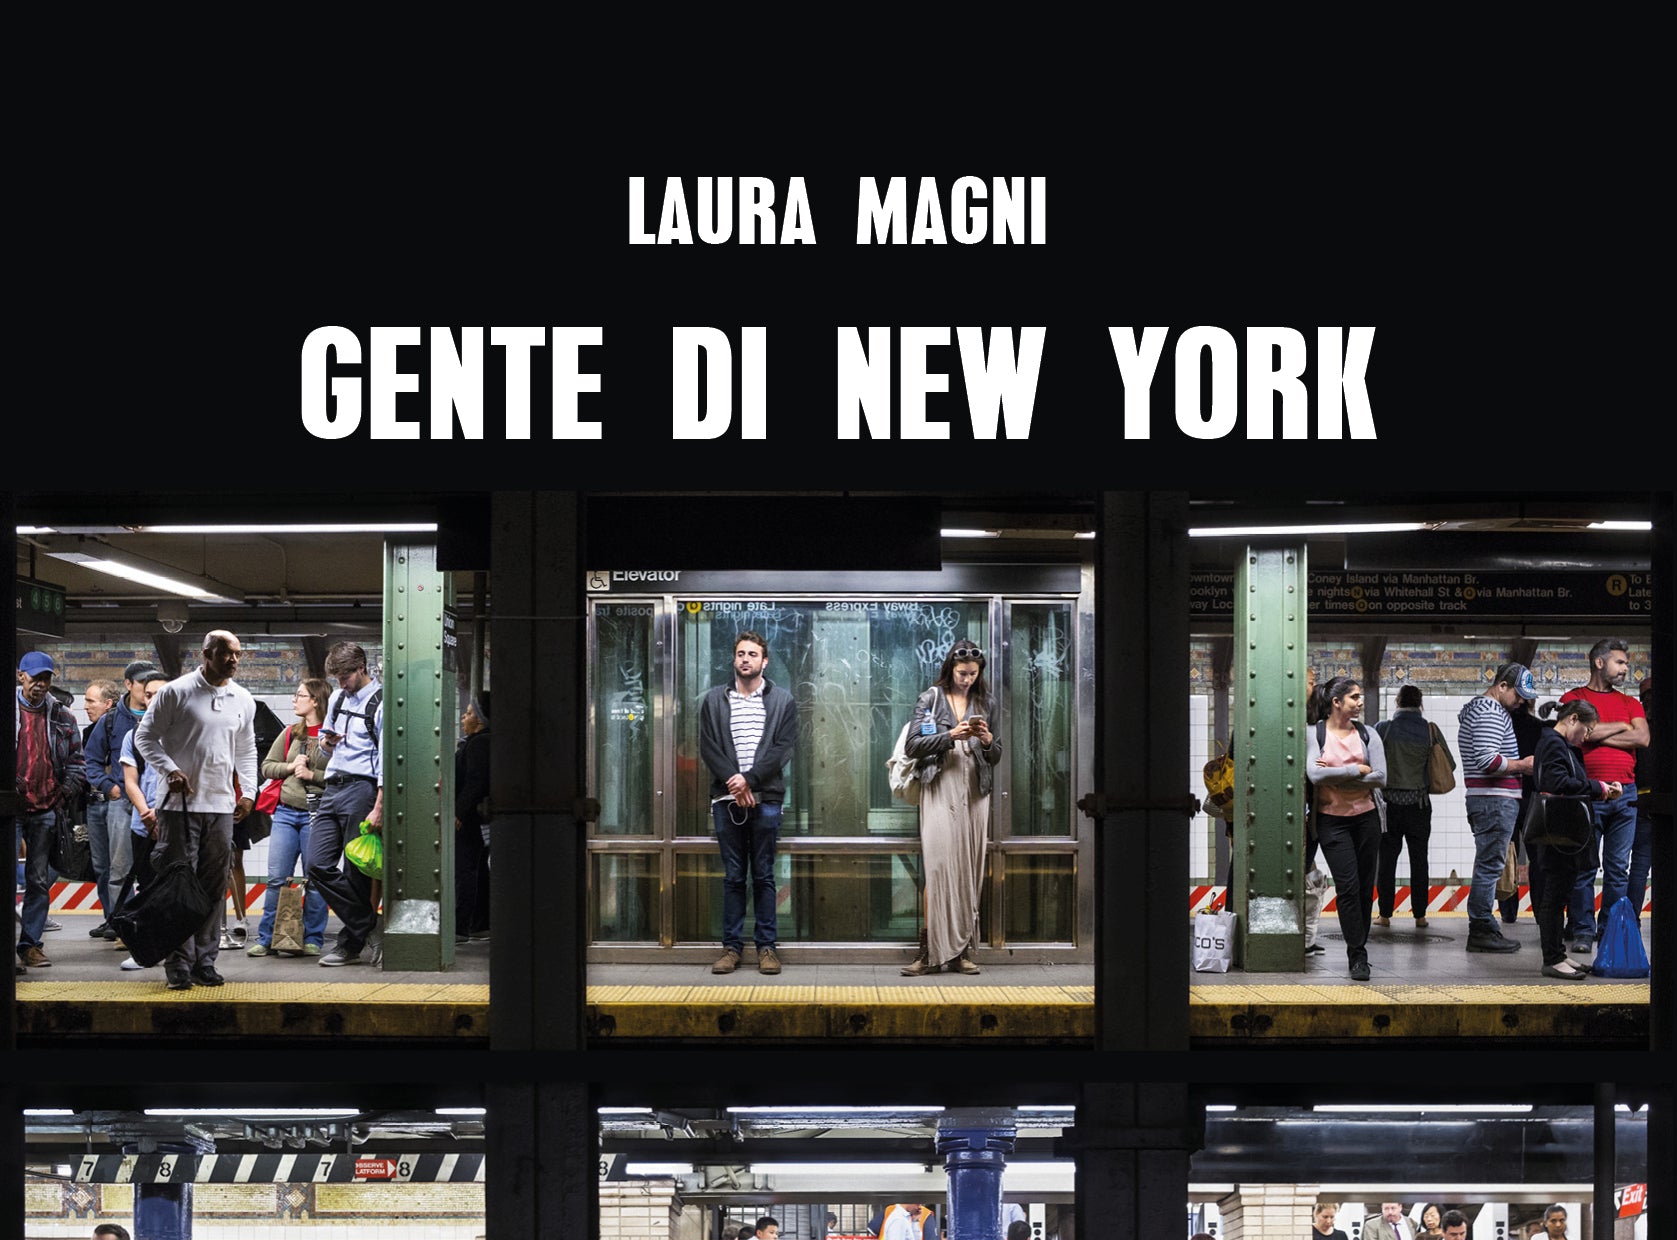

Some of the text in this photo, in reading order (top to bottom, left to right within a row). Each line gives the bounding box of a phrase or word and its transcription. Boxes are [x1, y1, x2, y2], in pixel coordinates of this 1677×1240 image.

[1308, 573, 1480, 585] Coney Island via Manhattan Br.
[1630, 574, 1642, 584] To
[1317, 587, 1351, 598] nights
[1365, 587, 1380, 597] via
[1384, 587, 1434, 597] Whitehall
[1437, 587, 1450, 597] St
[1454, 588, 1463, 597] &
[1477, 588, 1492, 598] via
[1496, 588, 1554, 598] Manhattan
[1557, 588, 1573, 598] Br.
[1325, 600, 1355, 610] times
[1368, 602, 1383, 610] on
[1386, 600, 1434, 612] opposite
[1439, 600, 1467, 610] track
[1629, 601, 1641, 610] to
[83, 1160, 411, 1178] 7 8 7 8
[599, 1160, 609, 1176] 8
[1622, 1184, 1643, 1206] Exit
